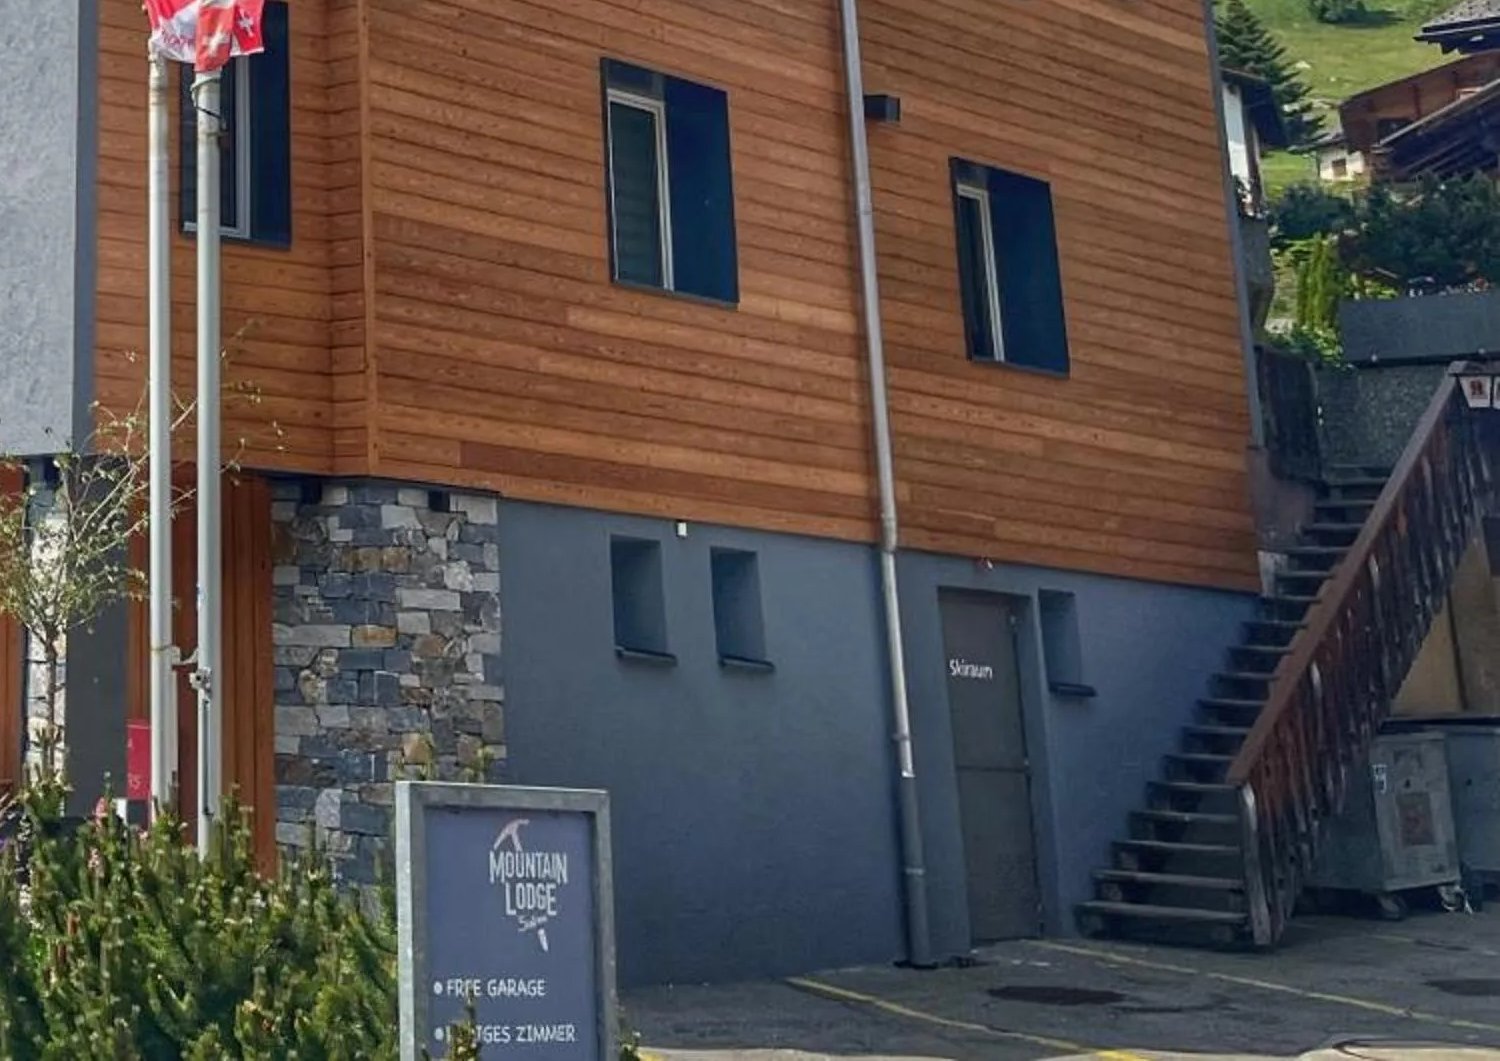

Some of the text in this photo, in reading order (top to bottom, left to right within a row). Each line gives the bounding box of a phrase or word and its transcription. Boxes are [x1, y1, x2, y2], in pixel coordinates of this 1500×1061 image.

[489, 850, 568, 885] MOUNTAIN
[505, 882, 558, 916] LODGE
[487, 978, 546, 997] GARAGE
[516, 1024, 576, 1043] ZIMMER
